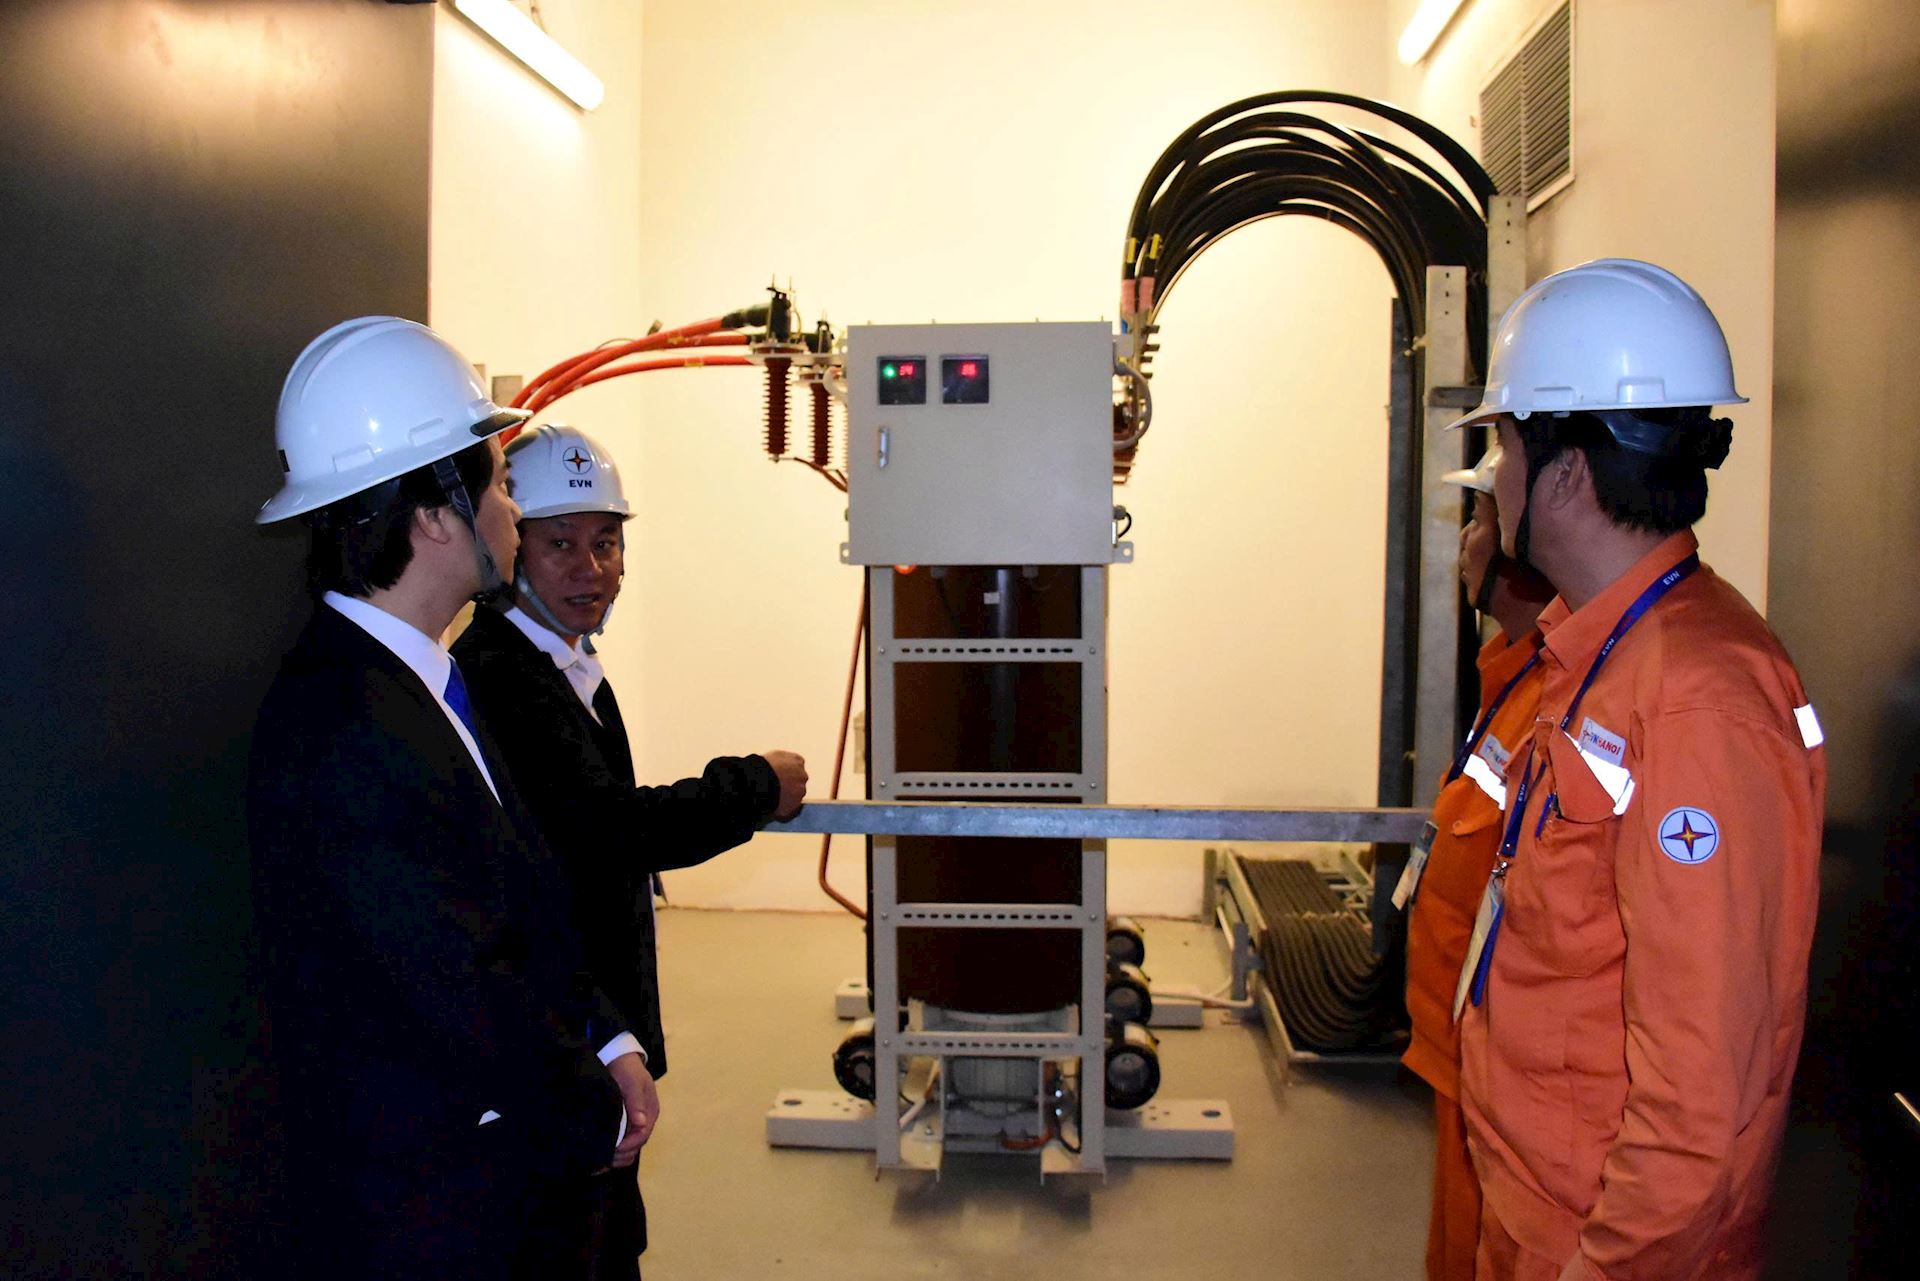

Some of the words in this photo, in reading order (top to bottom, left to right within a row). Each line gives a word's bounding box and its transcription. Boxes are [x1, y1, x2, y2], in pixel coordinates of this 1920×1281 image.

[569, 479, 592, 488] EVN
[1663, 570, 1681, 586] EVN
[1601, 638, 1615, 656] EVN
